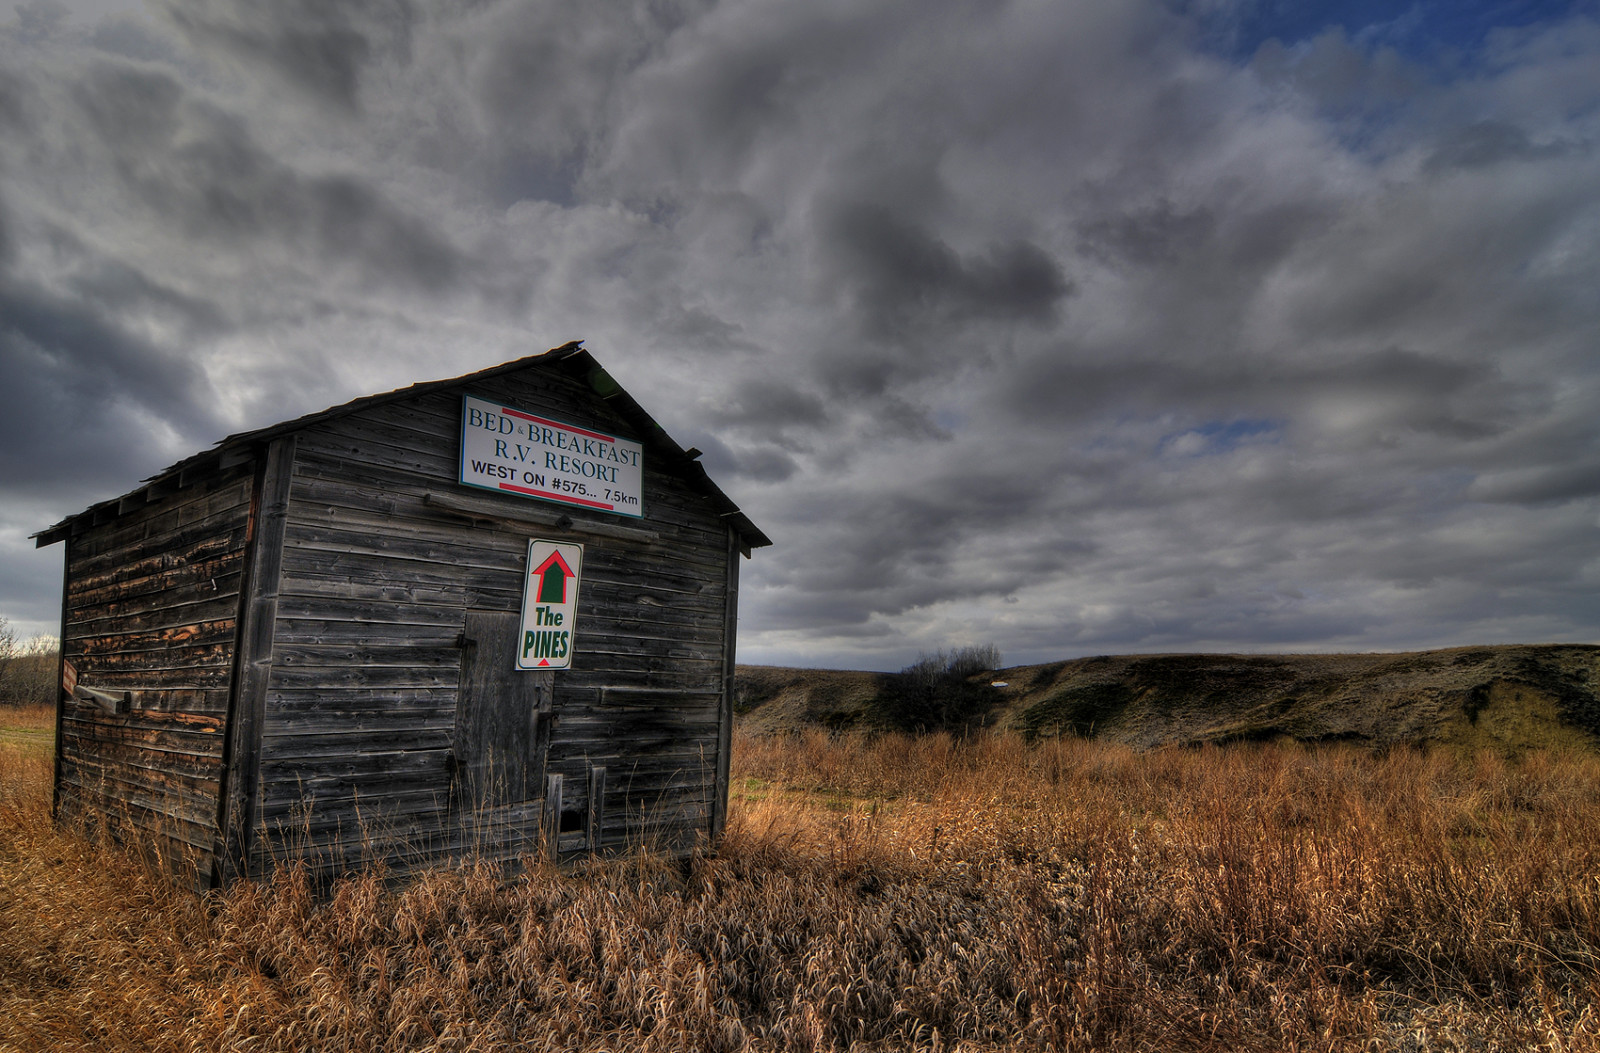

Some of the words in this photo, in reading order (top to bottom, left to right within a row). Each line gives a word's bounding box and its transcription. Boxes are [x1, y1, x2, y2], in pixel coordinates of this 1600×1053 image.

[469, 408, 514, 435] BED
[517, 426, 524, 435] &
[527, 423, 640, 467] BREAKFAST
[471, 459, 517, 480] WEST
[523, 472, 545, 487] ON
[552, 477, 597, 498] #575...
[604, 488, 638, 505] 7.5km
[494, 438, 536, 465] R.V.
[544, 451, 619, 483] RESORT
[535, 605, 563, 626] The
[522, 630, 569, 658] PINES
